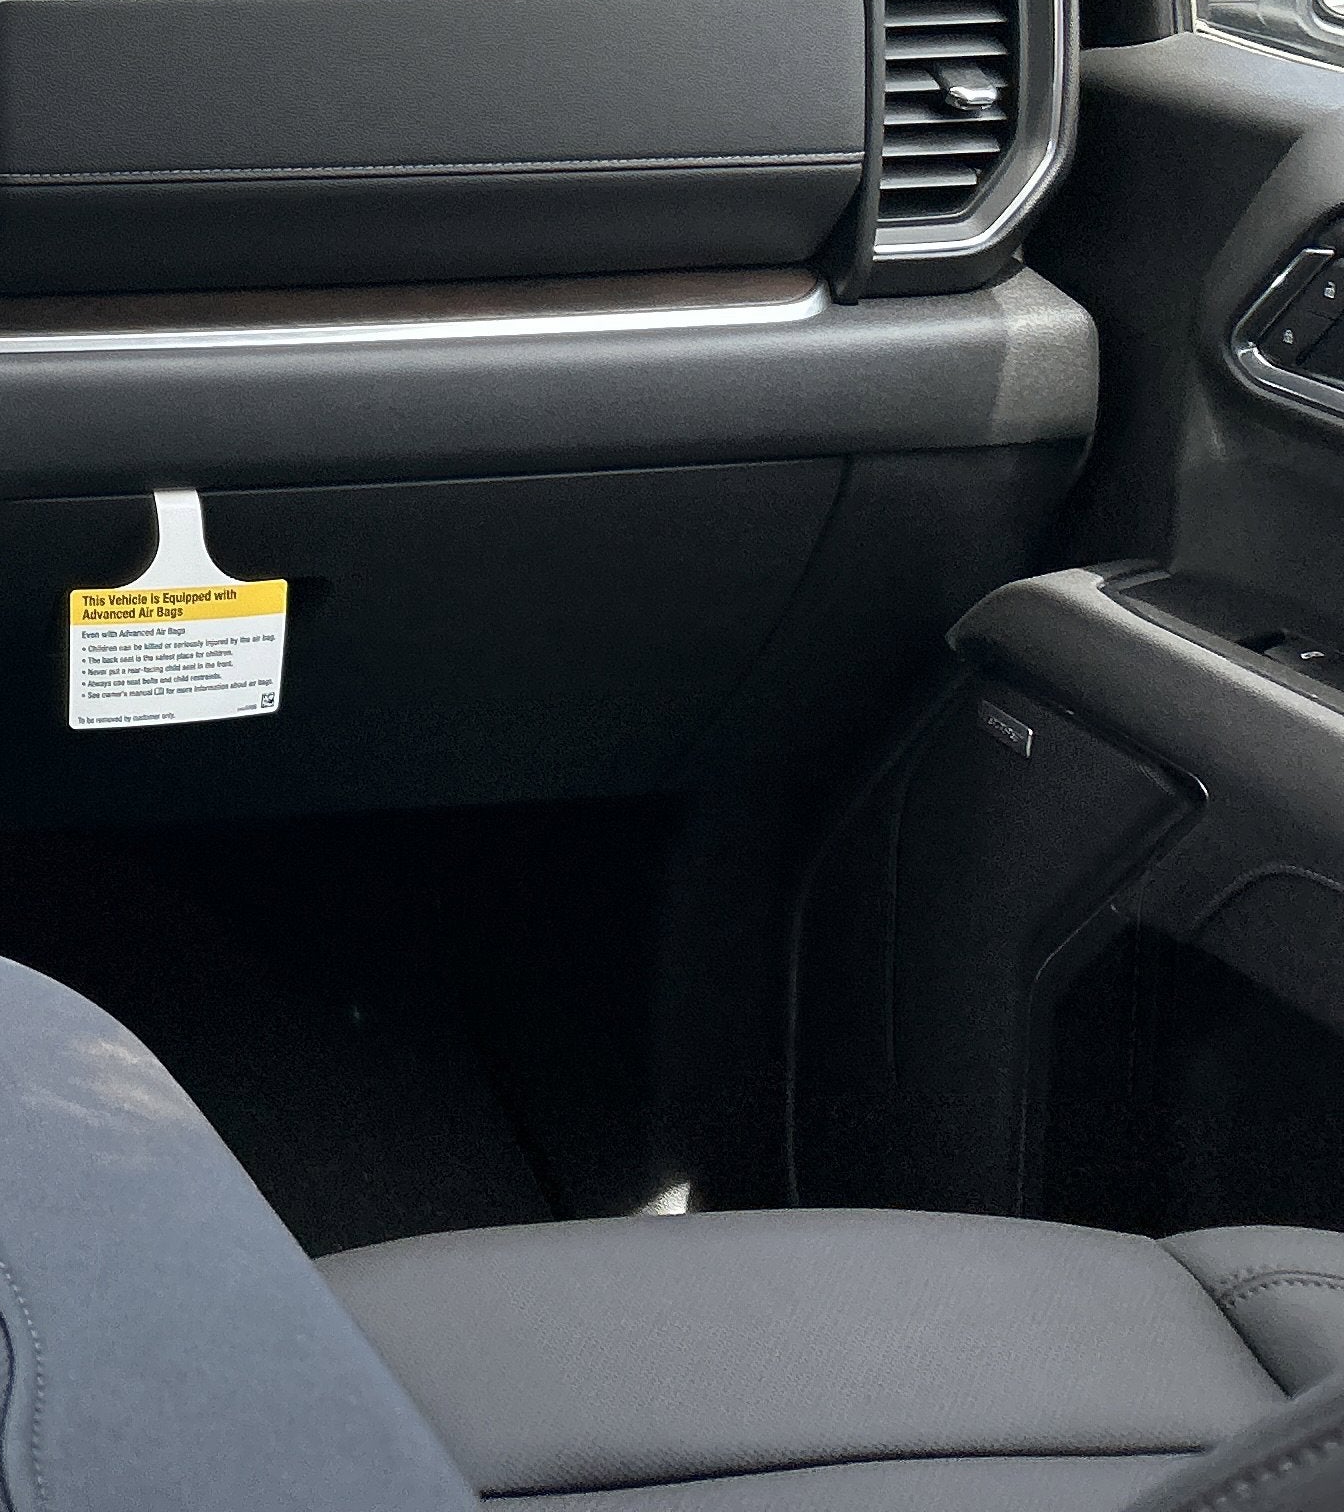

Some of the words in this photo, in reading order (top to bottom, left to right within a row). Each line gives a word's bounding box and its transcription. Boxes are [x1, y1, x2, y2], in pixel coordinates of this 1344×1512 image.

[82, 595, 105, 606] This
[108, 593, 147, 606] Vehicle
[163, 590, 212, 608] Equipped
[214, 589, 236, 600] with
[82, 608, 135, 620] Advanced
[139, 607, 153, 618] Air
[156, 606, 183, 622] Bags
[82, 631, 99, 639] Even
[102, 630, 117, 638] with
[119, 629, 154, 638] Advanced
[156, 628, 166, 636] Air
[168, 628, 185, 636] Bags
[176, 652, 193, 661] place
[108, 668, 120, 676] put
[87, 680, 111, 688] Always
[230, 680, 247, 688] about
[78, 716, 85, 724] To
